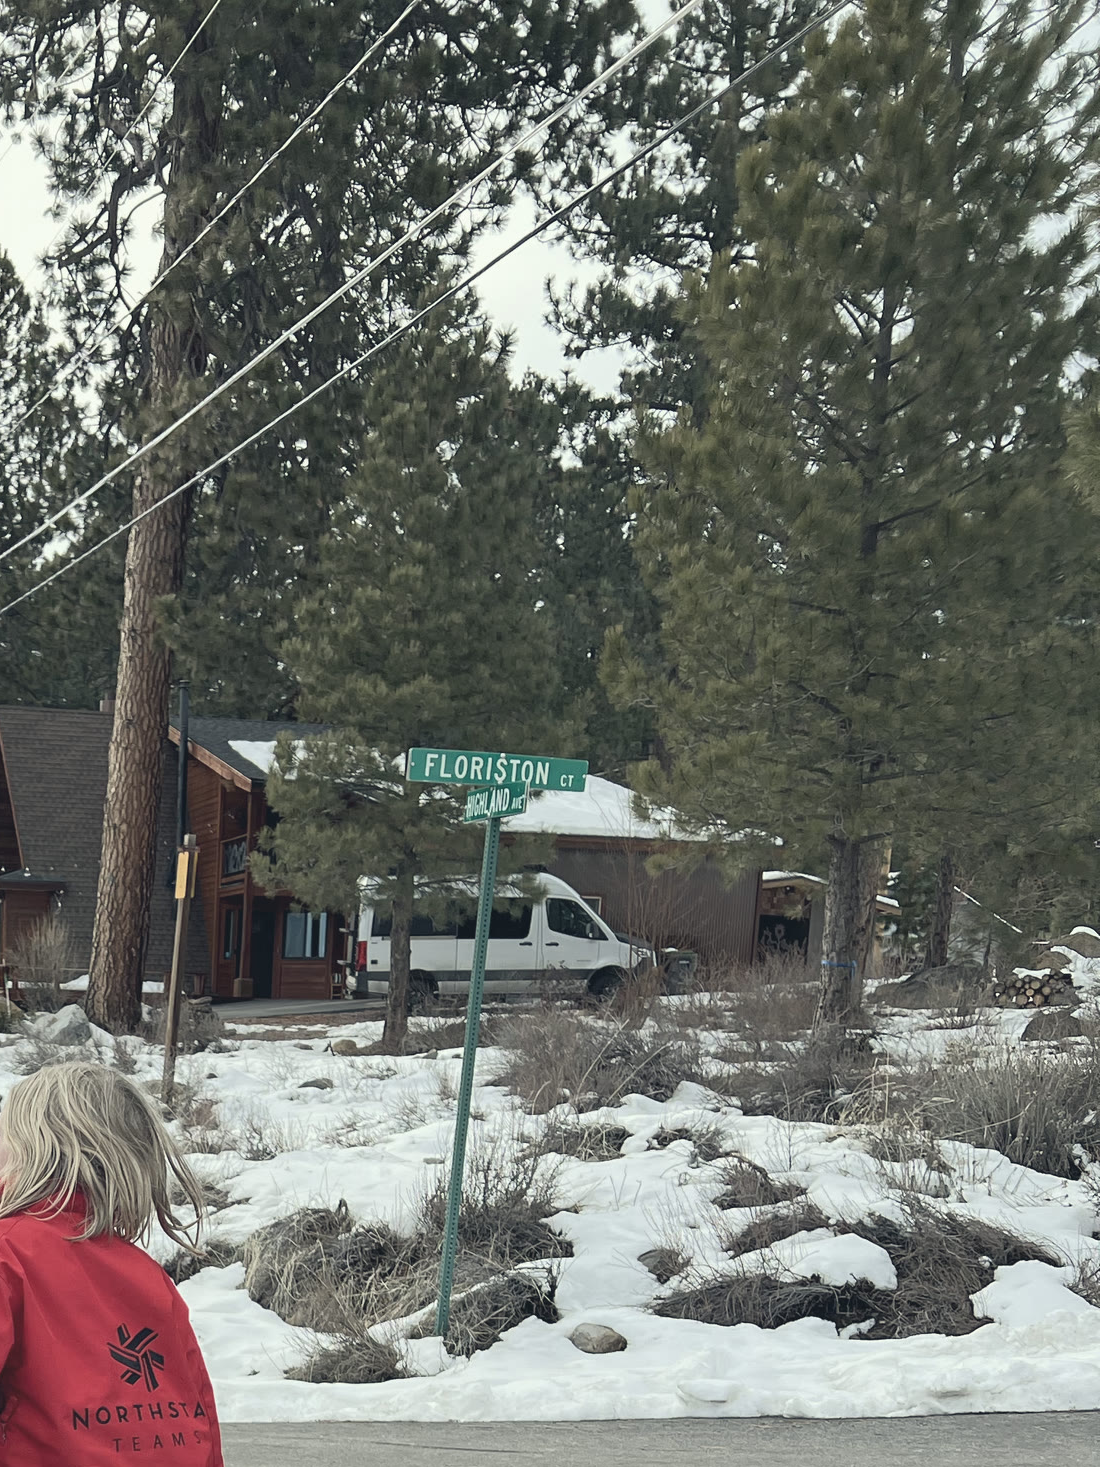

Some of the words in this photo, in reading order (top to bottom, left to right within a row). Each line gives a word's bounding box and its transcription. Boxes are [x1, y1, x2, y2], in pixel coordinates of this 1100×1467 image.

[424, 753, 550, 785] FLORISTON
[560, 774, 574, 788] CT
[466, 788, 510, 818] HIGHLAND
[511, 796, 523, 809] AVE
[72, 1402, 206, 1430] NORTHSTA
[113, 1430, 202, 1452] TEAMS
